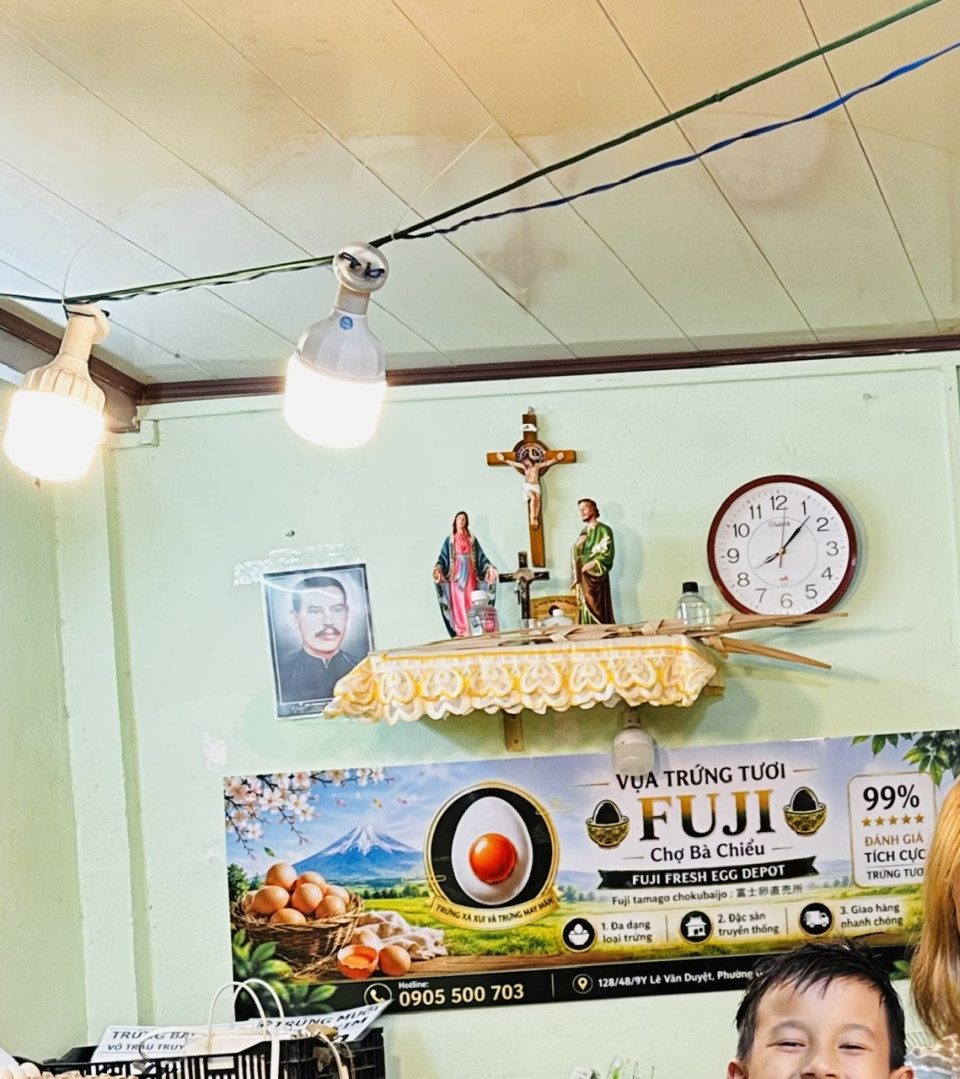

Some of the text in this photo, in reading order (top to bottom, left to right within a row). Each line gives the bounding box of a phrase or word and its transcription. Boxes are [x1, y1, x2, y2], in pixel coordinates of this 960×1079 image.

[770, 495, 788, 511] 12
[801, 501, 807, 515] 1
[750, 504, 762, 520] 11
[733, 523, 750, 538] 10
[816, 517, 829, 532] 2
[727, 548, 740, 564] 9
[826, 541, 839, 556] 3
[737, 572, 750, 587] 8
[821, 567, 834, 580] 4
[755, 588, 767, 603] 7
[805, 584, 818, 600] 5
[780, 593, 793, 609] 6
[664, 764, 732, 787] TRỨNG
[738, 761, 785, 780] TƯƠI
[863, 784, 920, 811] 99%
[637, 789, 775, 841] FUJI
[865, 831, 924, 847] ĐÁNH GIÁ
[651, 839, 765, 864] Chợ Bà Chiểu
[864, 849, 895, 863] TÍCH
[632, 864, 786, 886] FUJI FRESH EGG DEPOT
[866, 868, 925, 880] TRỨNG TƯƠ
[612, 896, 630, 907] Fuji
[633, 895, 670, 905] tamago
[672, 889, 728, 902] chokubaijo
[840, 903, 900, 915] 3. Giao hàng
[718, 911, 766, 923] 2. Đặc sản
[841, 916, 903, 928] nhanh chóng
[601, 919, 651, 931] 1. Đa dạng
[752, 923, 780, 935] thống
[603, 933, 653, 945] loại trứng
[398, 981, 429, 990] Hotline:
[598, 976, 647, 988] 128/48/9Y
[650, 975, 662, 985] Lê
[664, 973, 682, 983] Văn
[684, 972, 715, 984] Duyệt,
[399, 983, 524, 1007] 0905 500 703
[158, 1043, 185, 1051] TRUY
